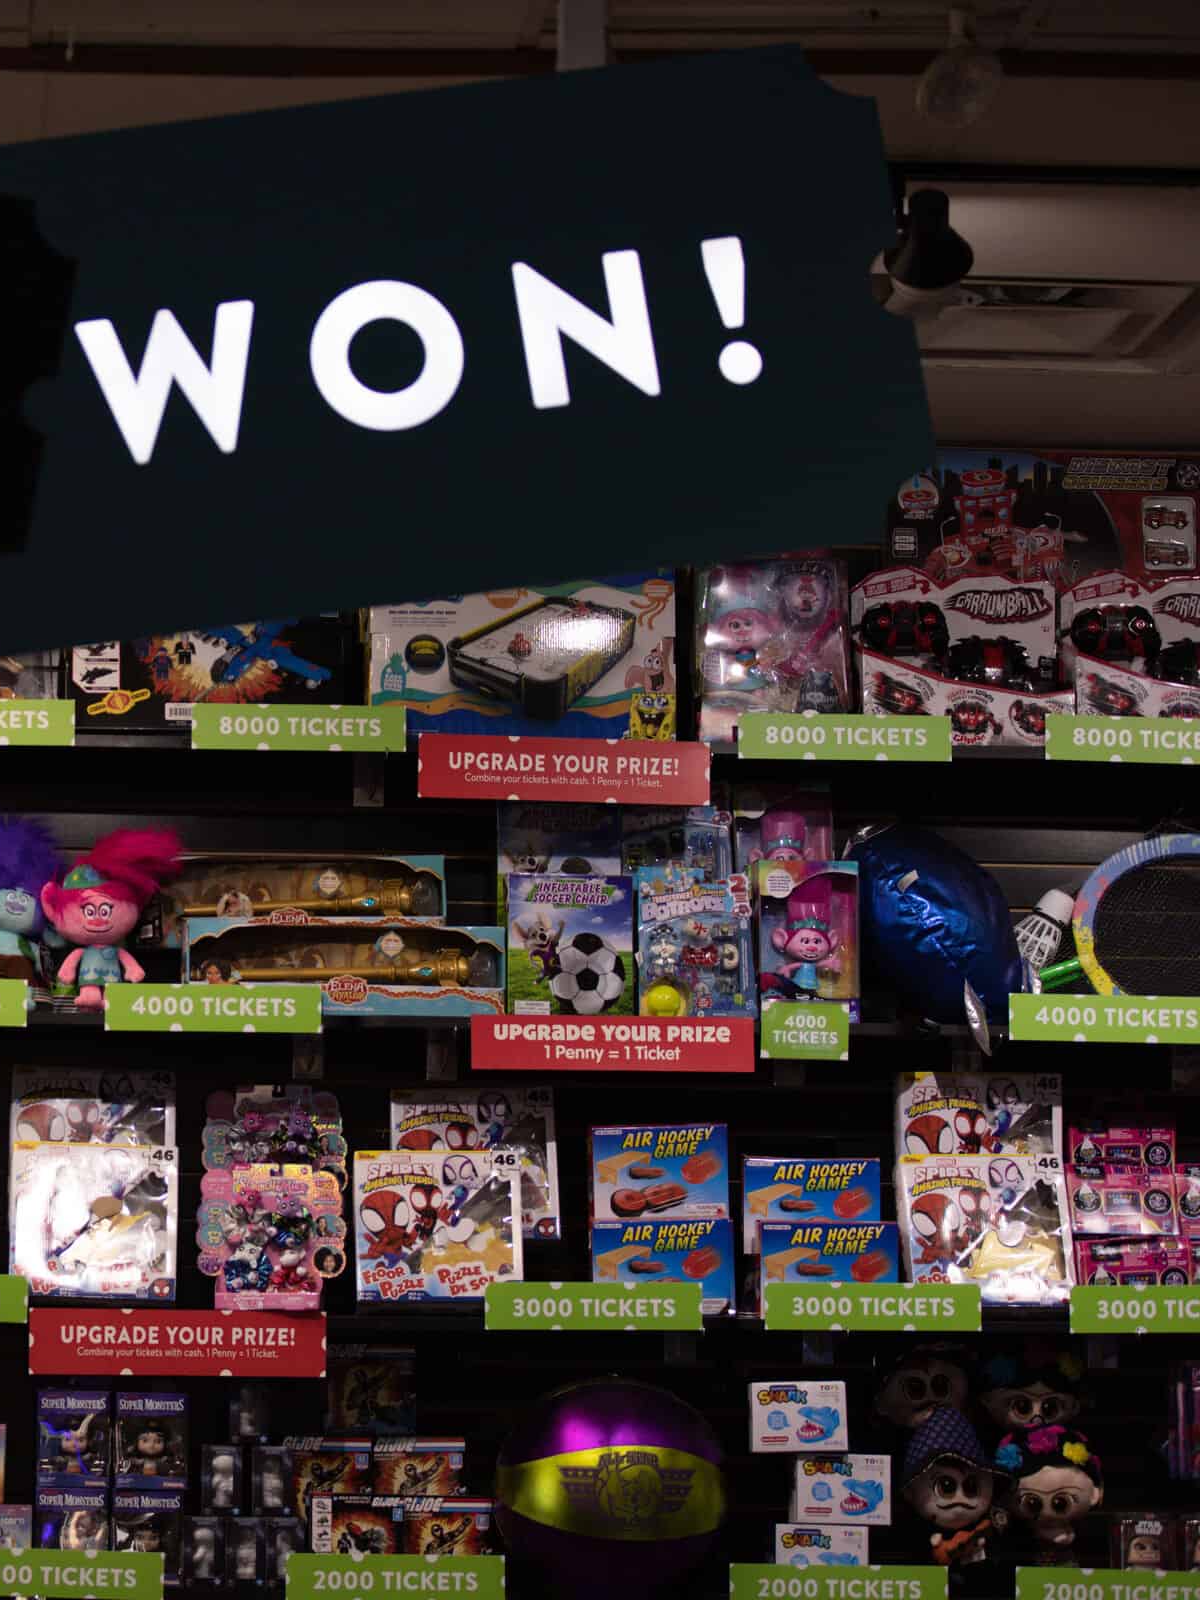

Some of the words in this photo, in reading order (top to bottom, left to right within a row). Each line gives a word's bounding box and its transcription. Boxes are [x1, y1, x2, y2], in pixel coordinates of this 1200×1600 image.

[75, 237, 762, 464] WON!
[220, 716, 279, 735] 8000
[288, 718, 381, 736] TICKETS
[766, 726, 825, 744] 8000
[833, 727, 926, 746] TICKETS
[1073, 728, 1132, 747] 8000
[1140, 730, 1200, 750] TICKE
[449, 752, 545, 774] UPGRADE
[553, 755, 608, 773] YOUR
[617, 757, 678, 779] PRIZE!
[534, 894, 572, 904] SOCCER
[575, 894, 609, 904] CHAIR
[132, 996, 193, 1015] 4000
[201, 997, 296, 1016] TICKETS
[785, 1014, 826, 1031] 4000
[1035, 1007, 1096, 1025] 4000
[1104, 1008, 1198, 1028] TICKETS
[602, 1025, 661, 1042] YOUR
[774, 1030, 838, 1045] TICKETS
[544, 1045, 550, 1058] 1
[556, 1045, 604, 1062] Penny
[624, 1046, 630, 1059] 1
[635, 1046, 680, 1060] Ticket
[621, 1132, 652, 1149] AIR
[657, 1126, 714, 1145] HOCKEY
[152, 1149, 175, 1162] 46
[652, 1141, 698, 1158] GAME
[494, 1153, 516, 1166] 46
[1038, 1157, 1059, 1169] 46
[773, 1164, 805, 1182] AIR
[809, 1160, 867, 1178] HOCKEY
[804, 1174, 850, 1191] GAME
[621, 1226, 652, 1244] AIR
[658, 1220, 715, 1239] HOCKEY
[790, 1226, 822, 1245] AIR
[827, 1224, 885, 1242] HOCKEY
[652, 1236, 699, 1254] GAME
[821, 1239, 869, 1255] GAME
[513, 1298, 572, 1317] 3000
[580, 1298, 675, 1317] TICKETS
[793, 1297, 852, 1316] 3000
[860, 1297, 954, 1316] TICKETS
[1098, 1300, 1156, 1319] 3000
[61, 1326, 159, 1344] UPGRADE
[166, 1327, 223, 1344] YOUR
[232, 1328, 294, 1345] PRIZE!
[757, 1389, 808, 1406] SHARK
[802, 1460, 854, 1477] SHARK
[781, 1533, 832, 1549] SHARK
[41, 1567, 136, 1587] TICKETS
[314, 1571, 373, 1590] 2000
[382, 1571, 477, 1591] TICKETS
[759, 1579, 818, 1597] 2000
[826, 1579, 921, 1599] TICKETS
[1044, 1584, 1103, 1600] 2000
